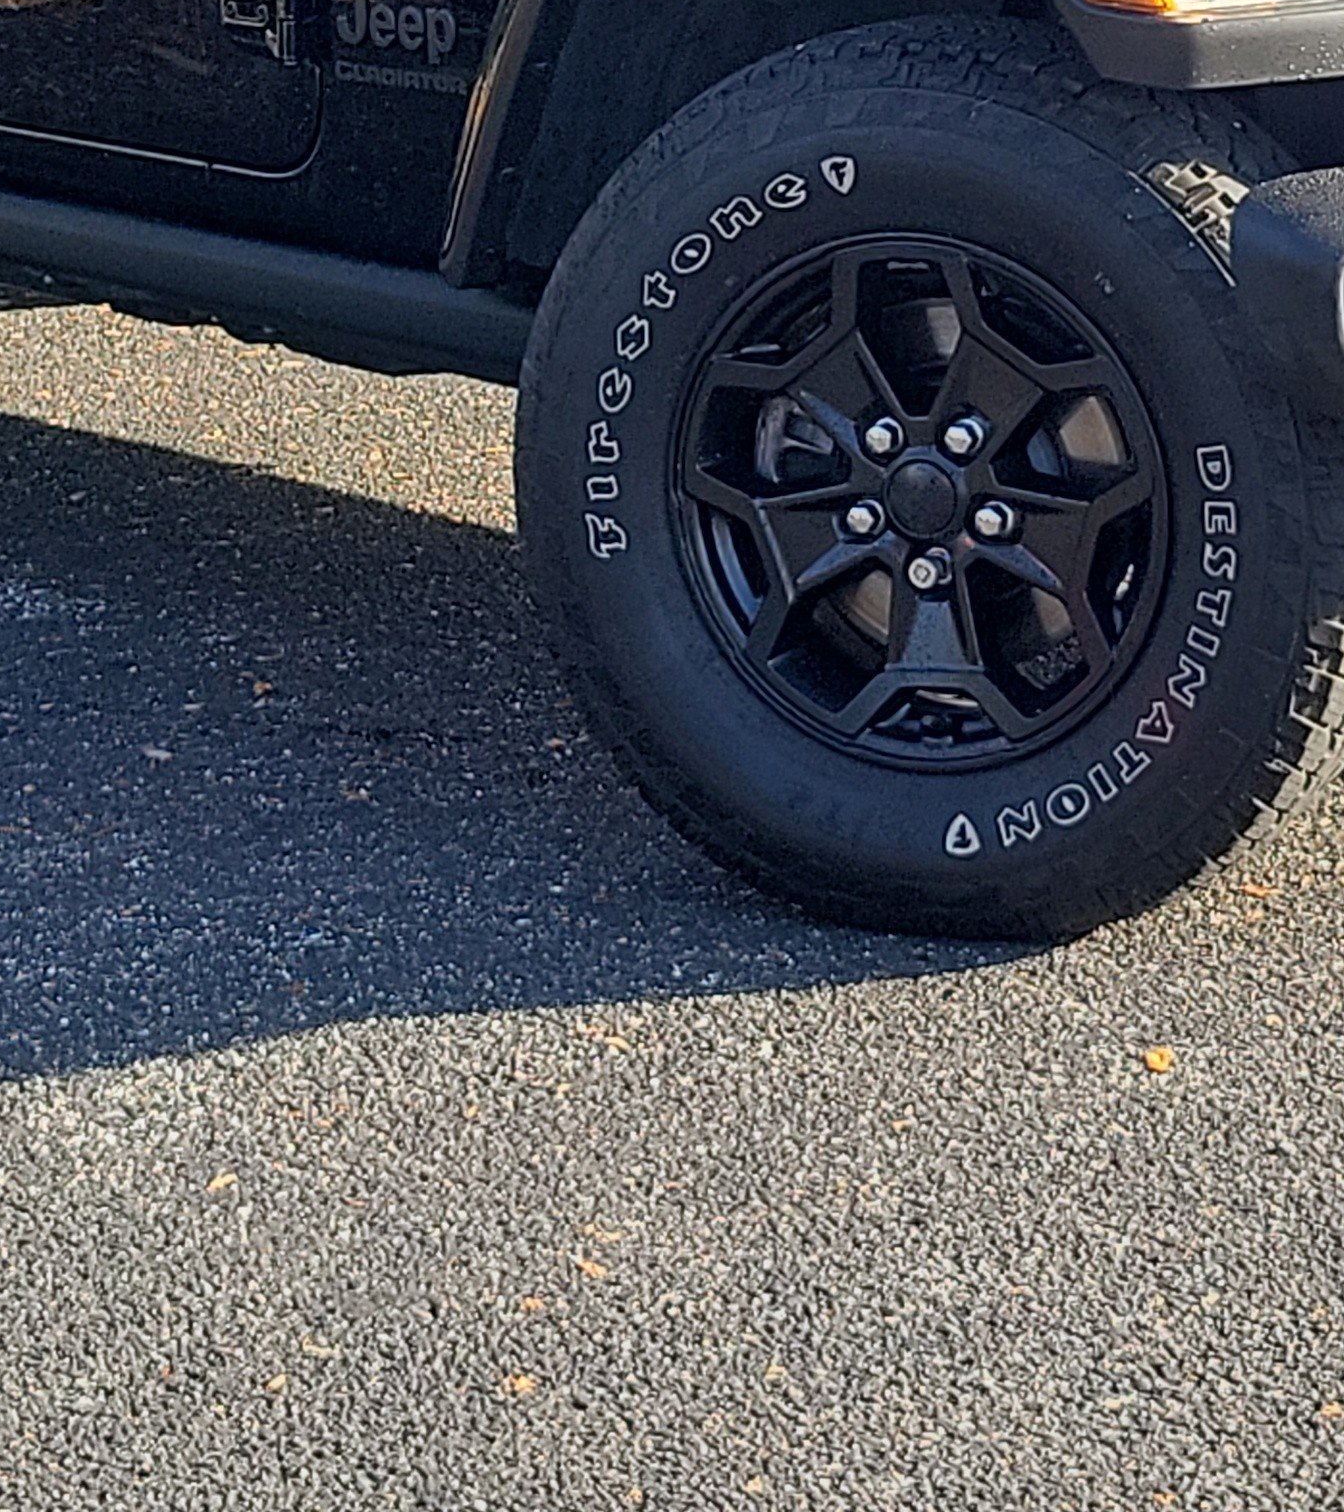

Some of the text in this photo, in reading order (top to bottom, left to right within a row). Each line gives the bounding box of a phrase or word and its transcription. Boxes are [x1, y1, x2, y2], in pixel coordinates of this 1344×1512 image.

[334, 59, 469, 96] GLADIATOR
[587, 171, 808, 560] Firestone
[996, 443, 1239, 846] DESTINATION
